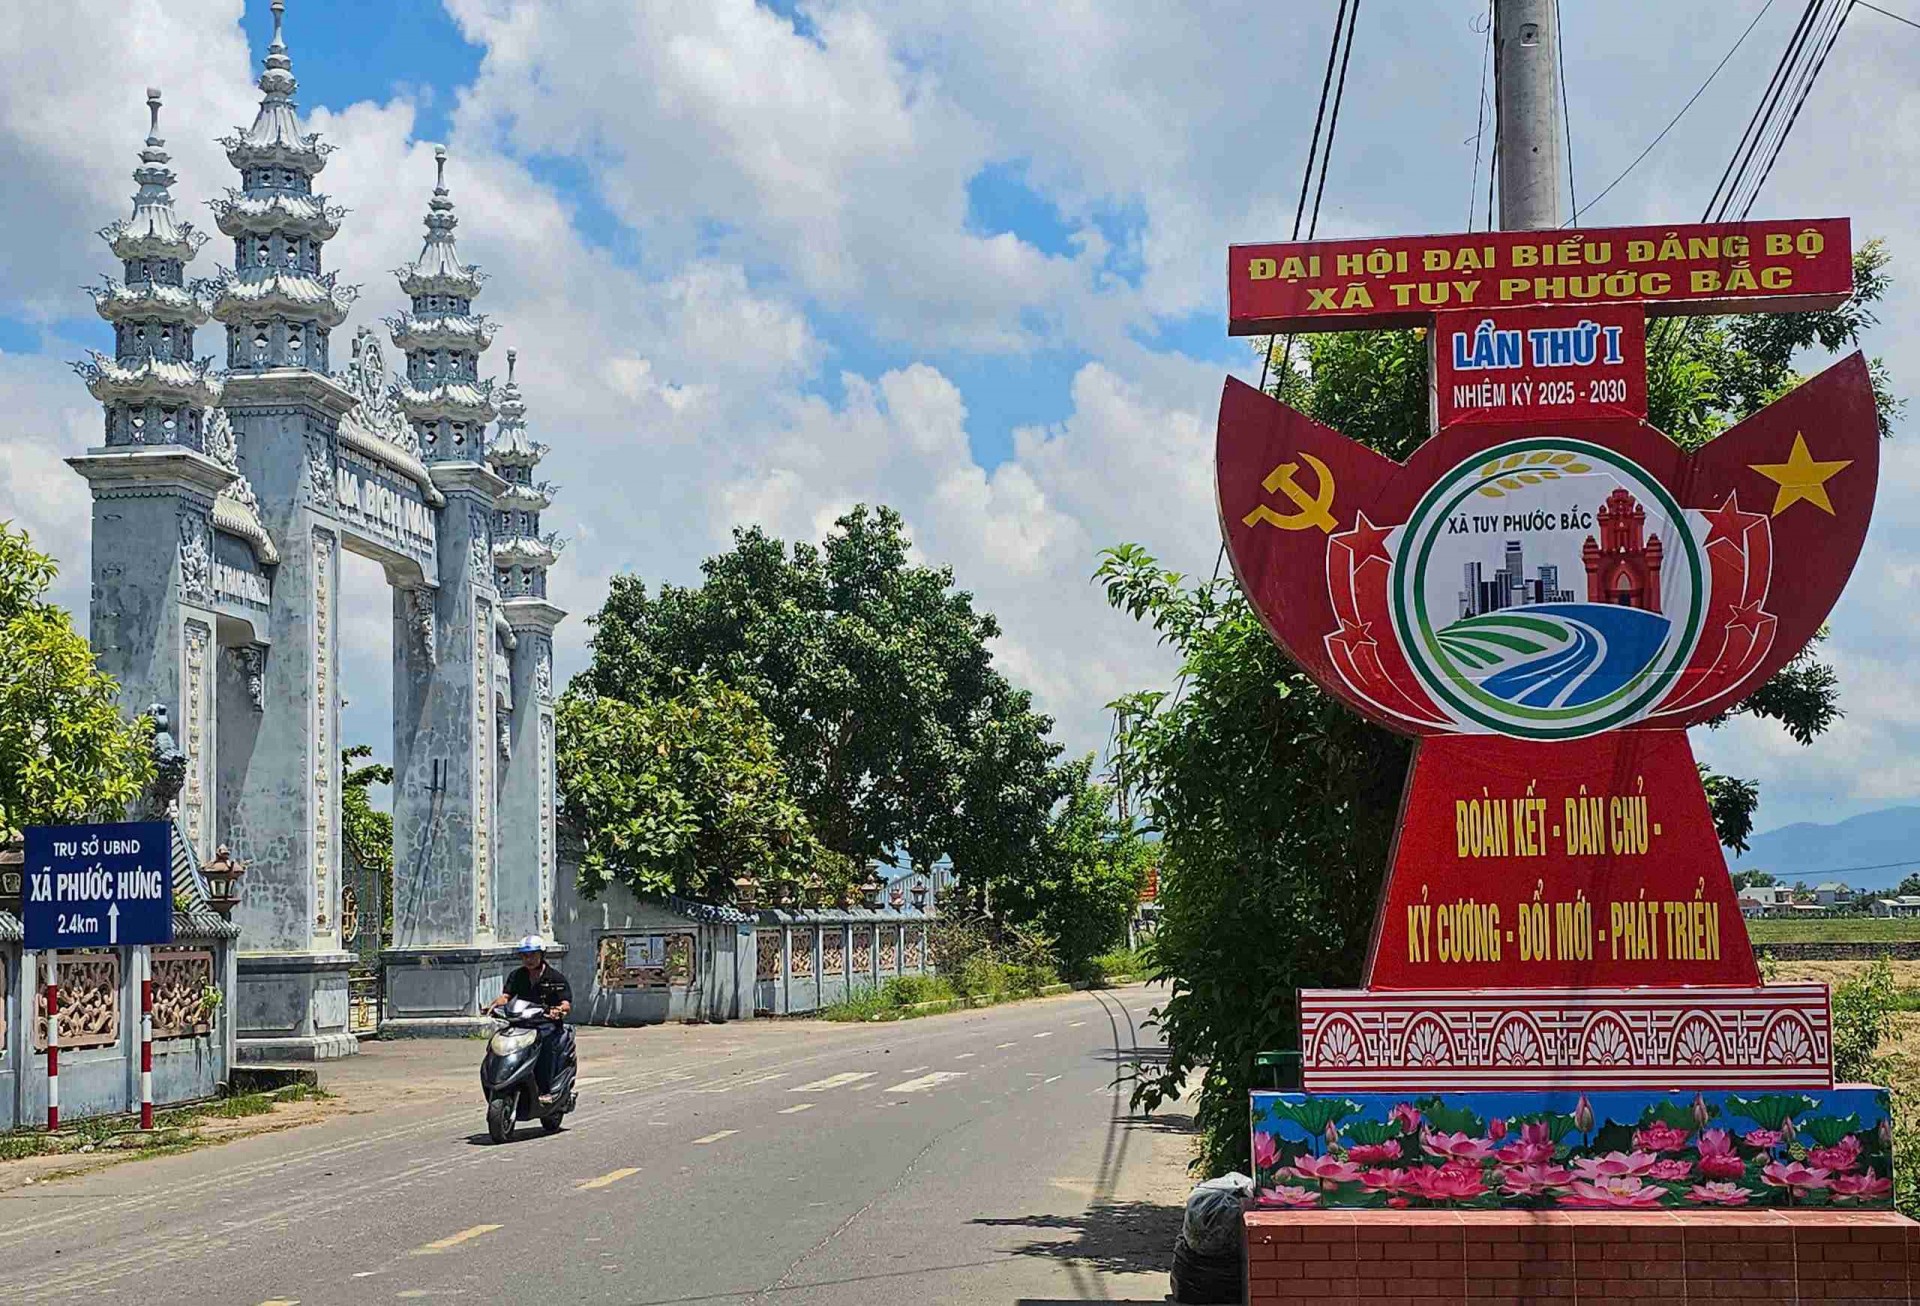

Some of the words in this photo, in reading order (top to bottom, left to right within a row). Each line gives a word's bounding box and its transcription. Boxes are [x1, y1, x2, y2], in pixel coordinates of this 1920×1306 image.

[1248, 255, 1321, 284] ĐẠI
[1336, 247, 1408, 279] HỘI
[1422, 246, 1496, 275] ĐẠI
[1511, 234, 1612, 268] BIỂU
[1626, 231, 1750, 263] ĐẢNG
[1765, 227, 1825, 260] BỘ
[1306, 281, 1374, 311] XÃ
[1389, 280, 1481, 307] TUY
[1499, 269, 1672, 301] PHƯỚC
[1690, 260, 1793, 294] BẮC
[1452, 318, 1523, 371] LẦN
[1527, 319, 1601, 368] THỨ
[1602, 326, 1624, 365] I
[1453, 377, 1506, 413] NHIỆM
[1511, 375, 1534, 406] KỲ
[1538, 380, 1576, 405] 2025
[1589, 378, 1628, 404] 2030
[1448, 512, 1469, 534] XÃ
[1472, 515, 1499, 534] TUY
[1503, 508, 1556, 532] PHƯỚC
[1560, 504, 1592, 530] BẮC
[1455, 786, 1509, 858] ĐOÀN
[1513, 778, 1547, 857] KẾT
[1565, 784, 1606, 856] DÂN
[1610, 775, 1649, 855] CHỦ
[53, 841, 78, 860] TRỤ
[81, 833, 99, 856] SỞ
[103, 839, 141, 855] UBND
[30, 865, 53, 902] XÃ
[57, 862, 114, 901] PHƯỚC
[117, 864, 162, 900] HƯNG
[57, 912, 99, 934] 2.4km
[1407, 884, 1431, 962] KỶ
[1436, 898, 1501, 962] CƯƠNG
[1518, 878, 1551, 961] ĐỔI
[1555, 889, 1593, 961] MỚI
[1610, 888, 1659, 960] PHÁT
[1663, 876, 1720, 960] TRIỂN
